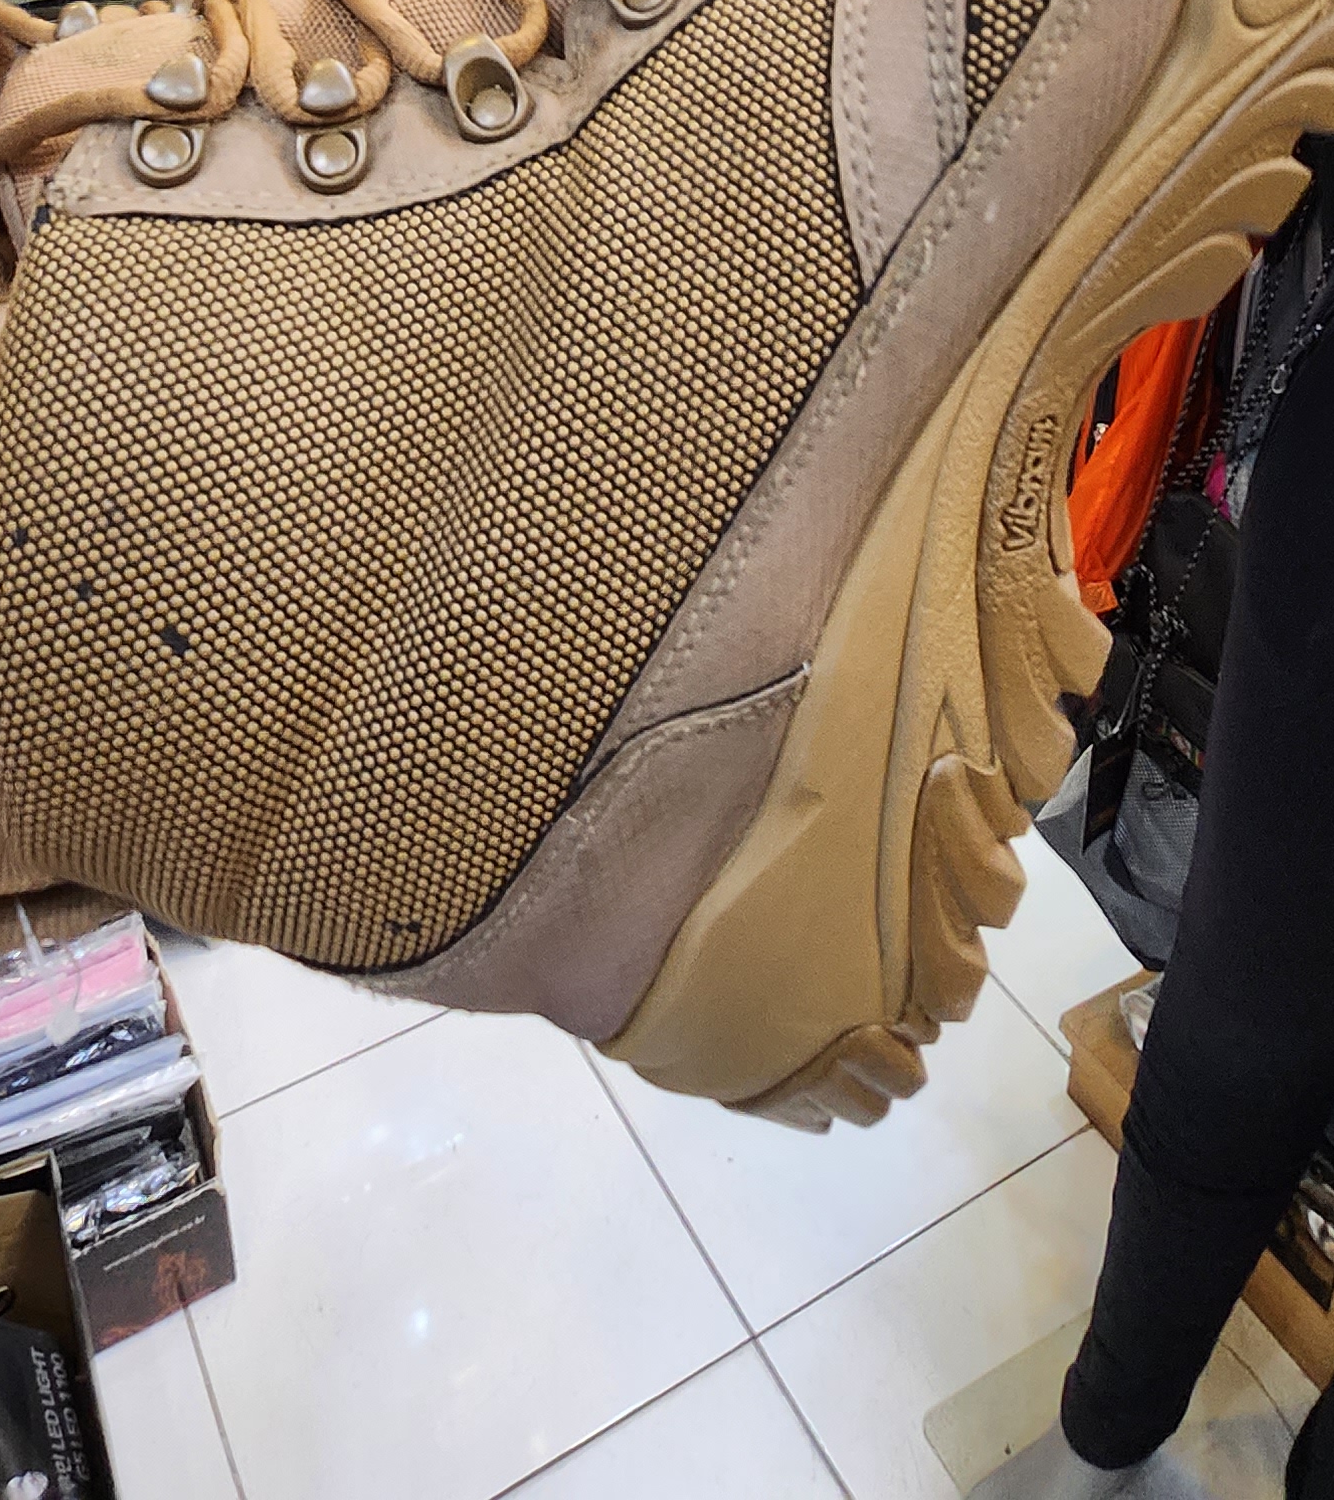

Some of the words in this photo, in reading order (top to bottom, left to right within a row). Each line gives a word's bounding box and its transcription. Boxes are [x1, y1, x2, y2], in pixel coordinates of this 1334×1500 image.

[1001, 414, 1057, 552] Vibram
[31, 1346, 53, 1407] LIGHT
[44, 1409, 63, 1450] LED
